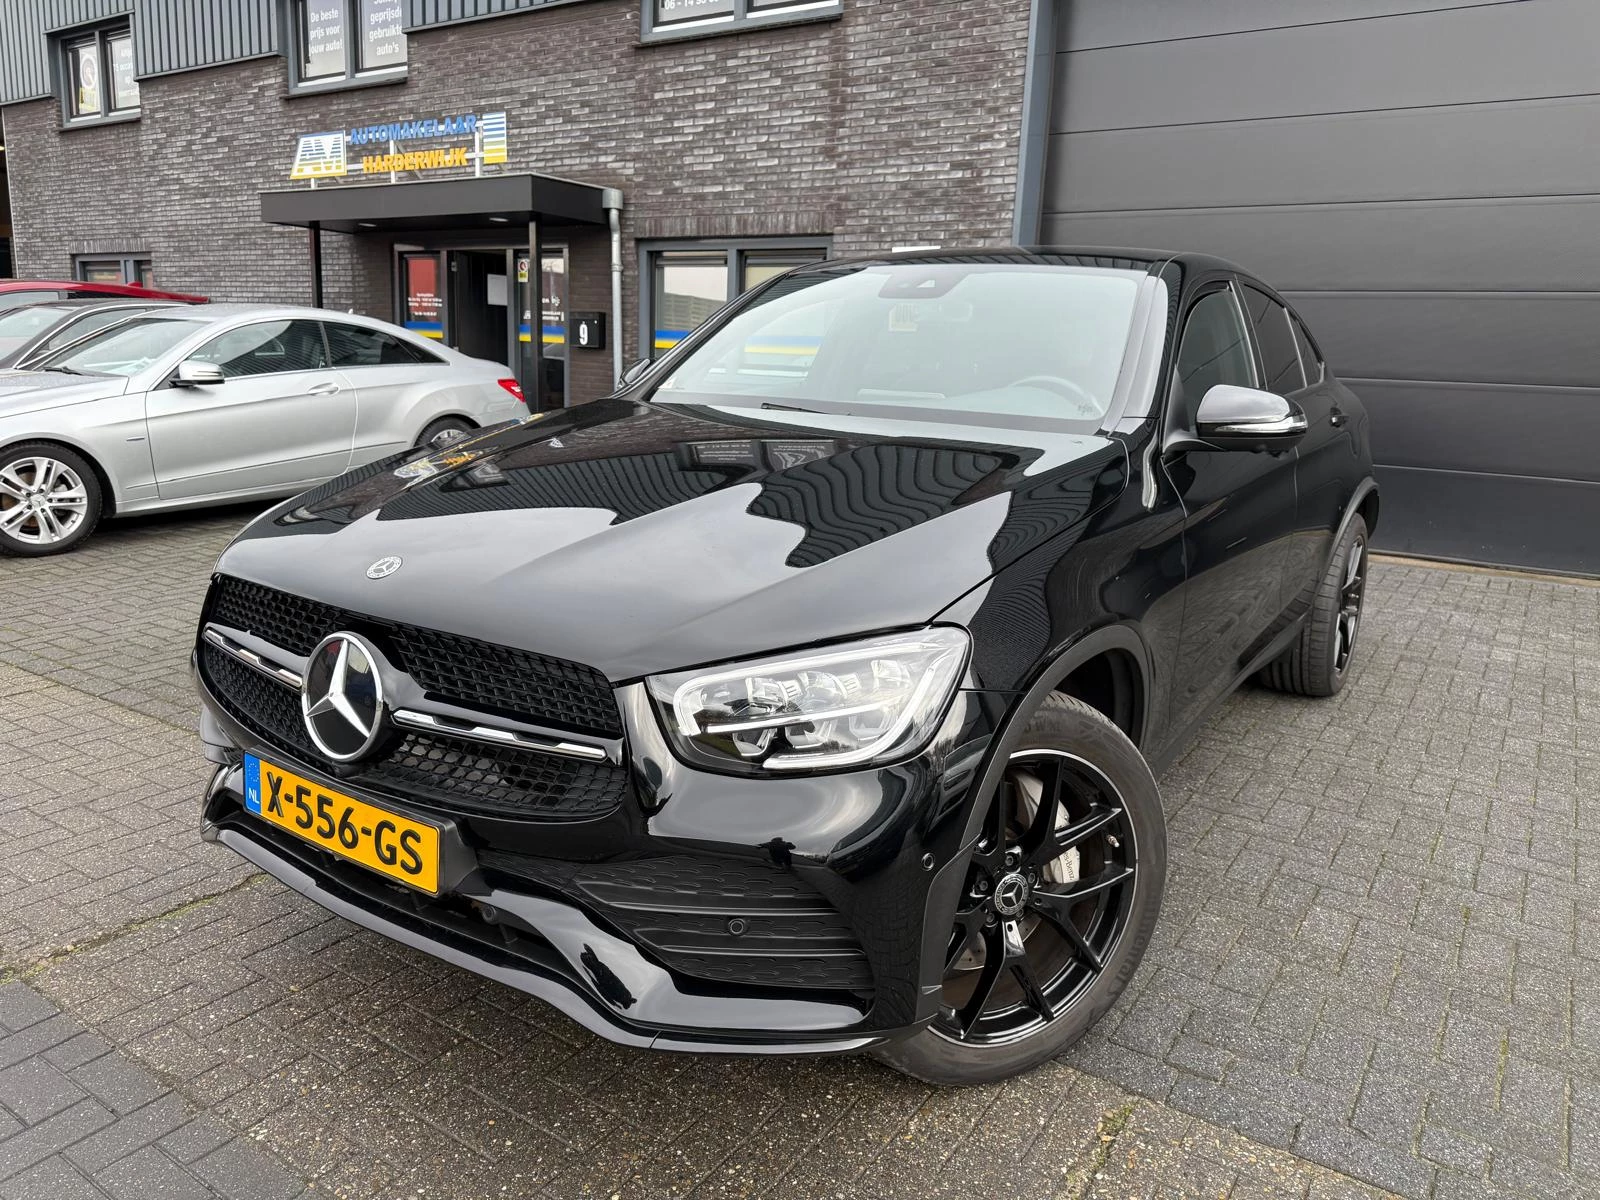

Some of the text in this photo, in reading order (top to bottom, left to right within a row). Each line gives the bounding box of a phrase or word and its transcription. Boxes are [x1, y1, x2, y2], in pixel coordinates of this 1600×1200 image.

[311, 8, 339, 22] De beste
[310, 25, 340, 40] prijs voor
[325, 38, 343, 52] auto!
[376, 41, 400, 56] auto's
[350, 115, 477, 145] AUTOMAKELAAR
[362, 147, 468, 173] HARDERWIJK
[579, 323, 589, 346] 9
[248, 787, 261, 806] NL
[267, 771, 423, 875] X-556-GS
